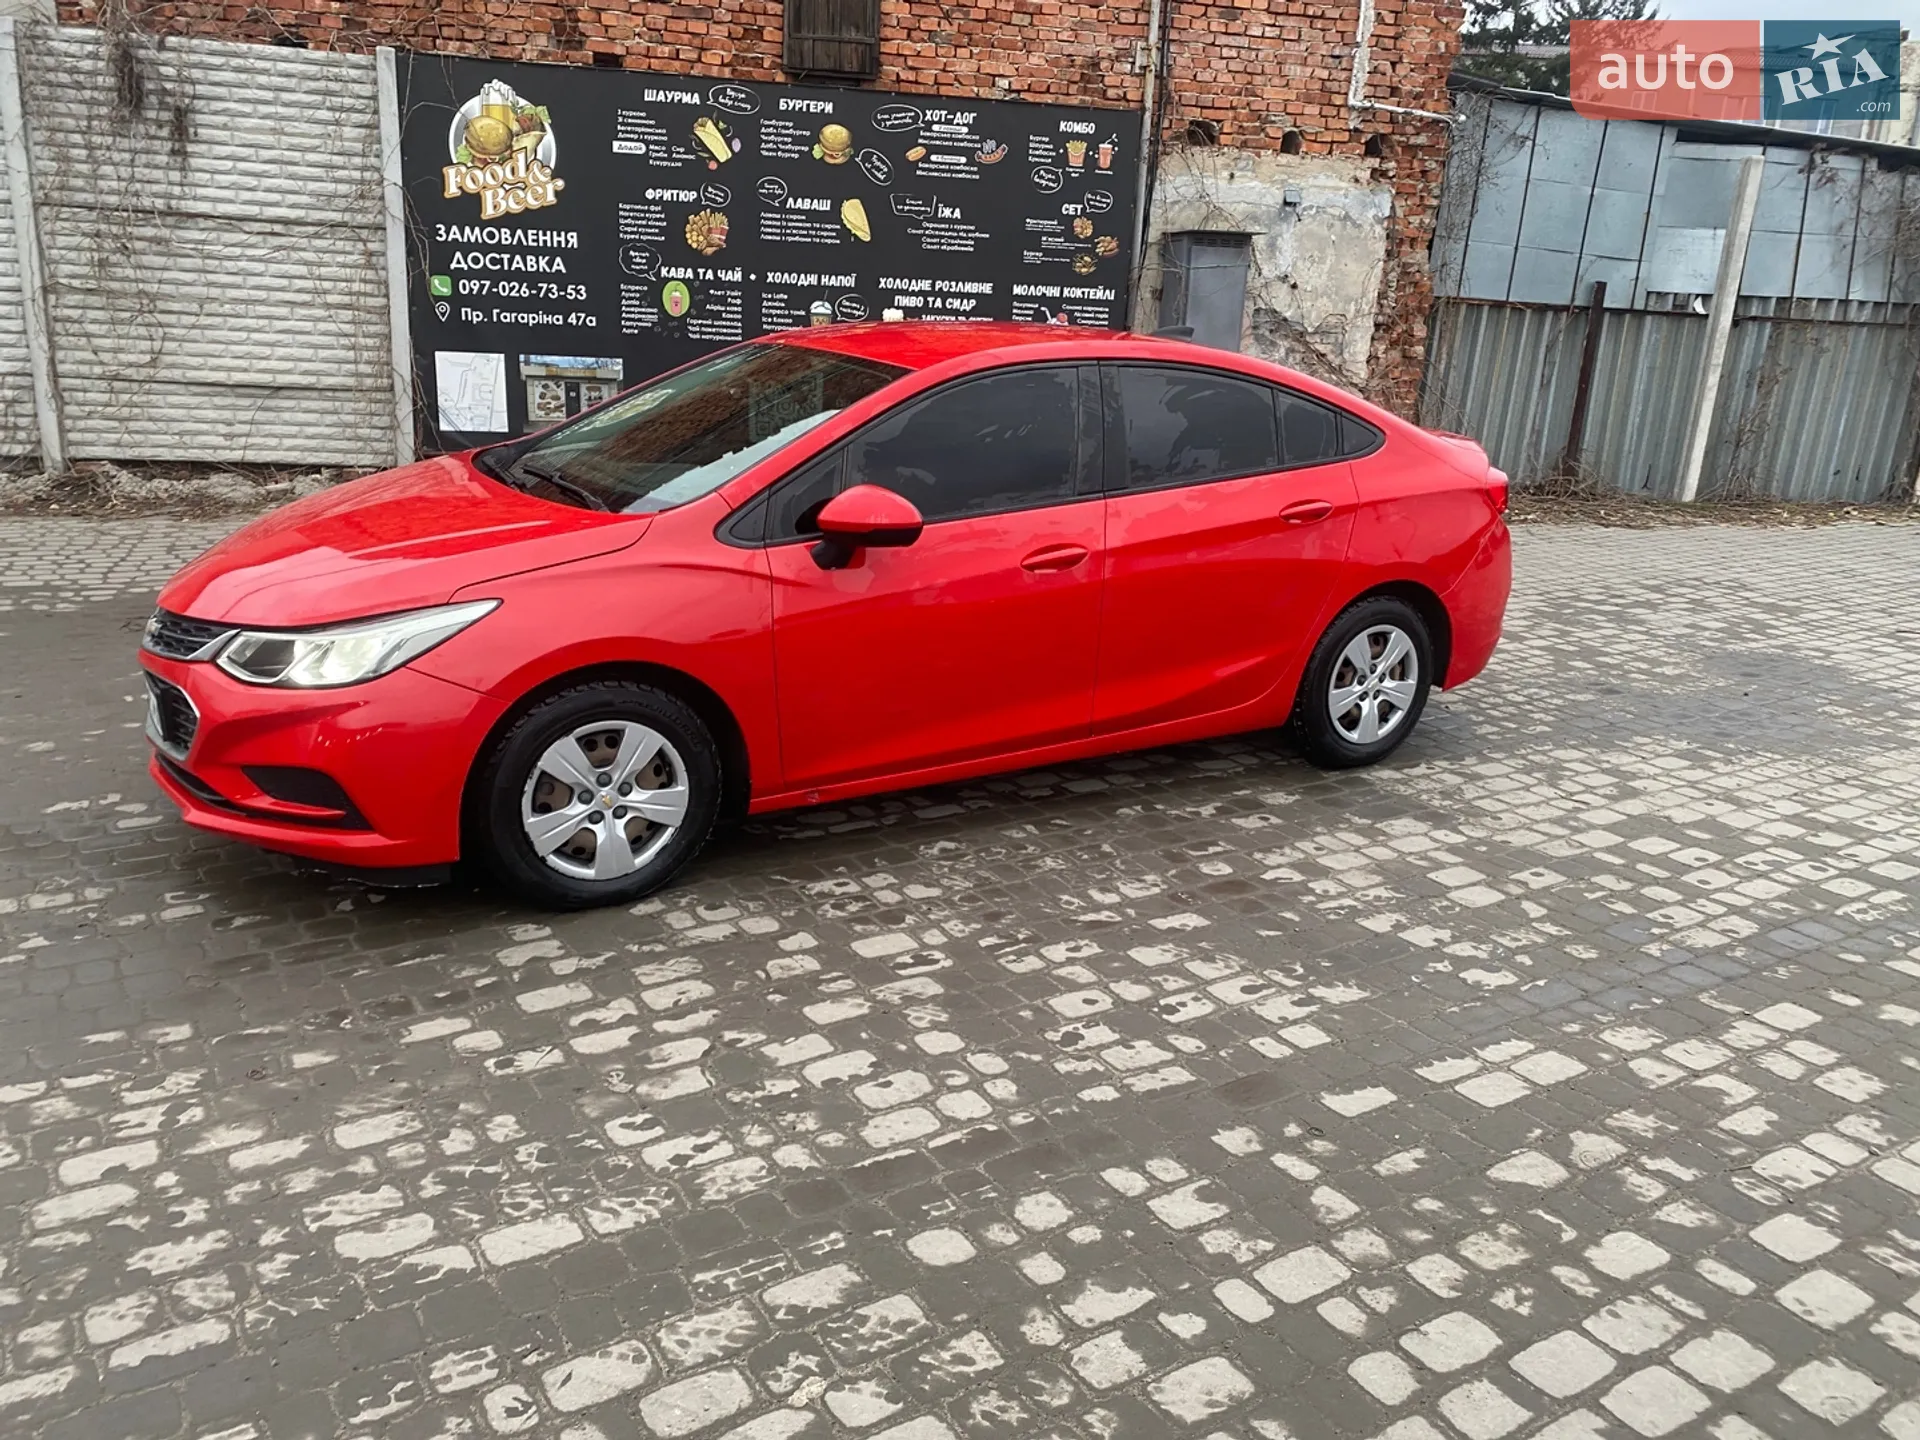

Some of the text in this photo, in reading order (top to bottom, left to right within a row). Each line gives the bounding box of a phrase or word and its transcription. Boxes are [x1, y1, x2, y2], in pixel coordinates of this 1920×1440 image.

[644, 88, 700, 105] ШАУРМА
[779, 98, 833, 114] БУРГЕРИ
[925, 109, 977, 125] ХОТ-ДОГ
[1059, 120, 1095, 134] КОМБО
[480, 178, 565, 220] Beer
[645, 188, 697, 202] ФРИТЮР
[786, 197, 831, 210] ЛАВАШ
[938, 204, 961, 219] ЇЖА
[1062, 203, 1083, 215] СЕТ
[435, 224, 578, 249] ЗАМОВЛЕННЯ
[450, 251, 567, 273] ДОСТАВКА
[661, 266, 742, 282] КАВА ТА ЧАЙ
[766, 272, 857, 287] ХОЛОДНІ НАПОЇ
[458, 279, 587, 300] 097-026-73-53
[879, 277, 993, 294] ХОЛОДНЕ РОЗЛИВНЕ
[1013, 284, 1115, 300] МОЛОЧНІ КОКТЕЙЛІ
[894, 295, 976, 312] ПИВО ТА СИДР
[461, 307, 597, 327] Пр. Гагаріна 47а
